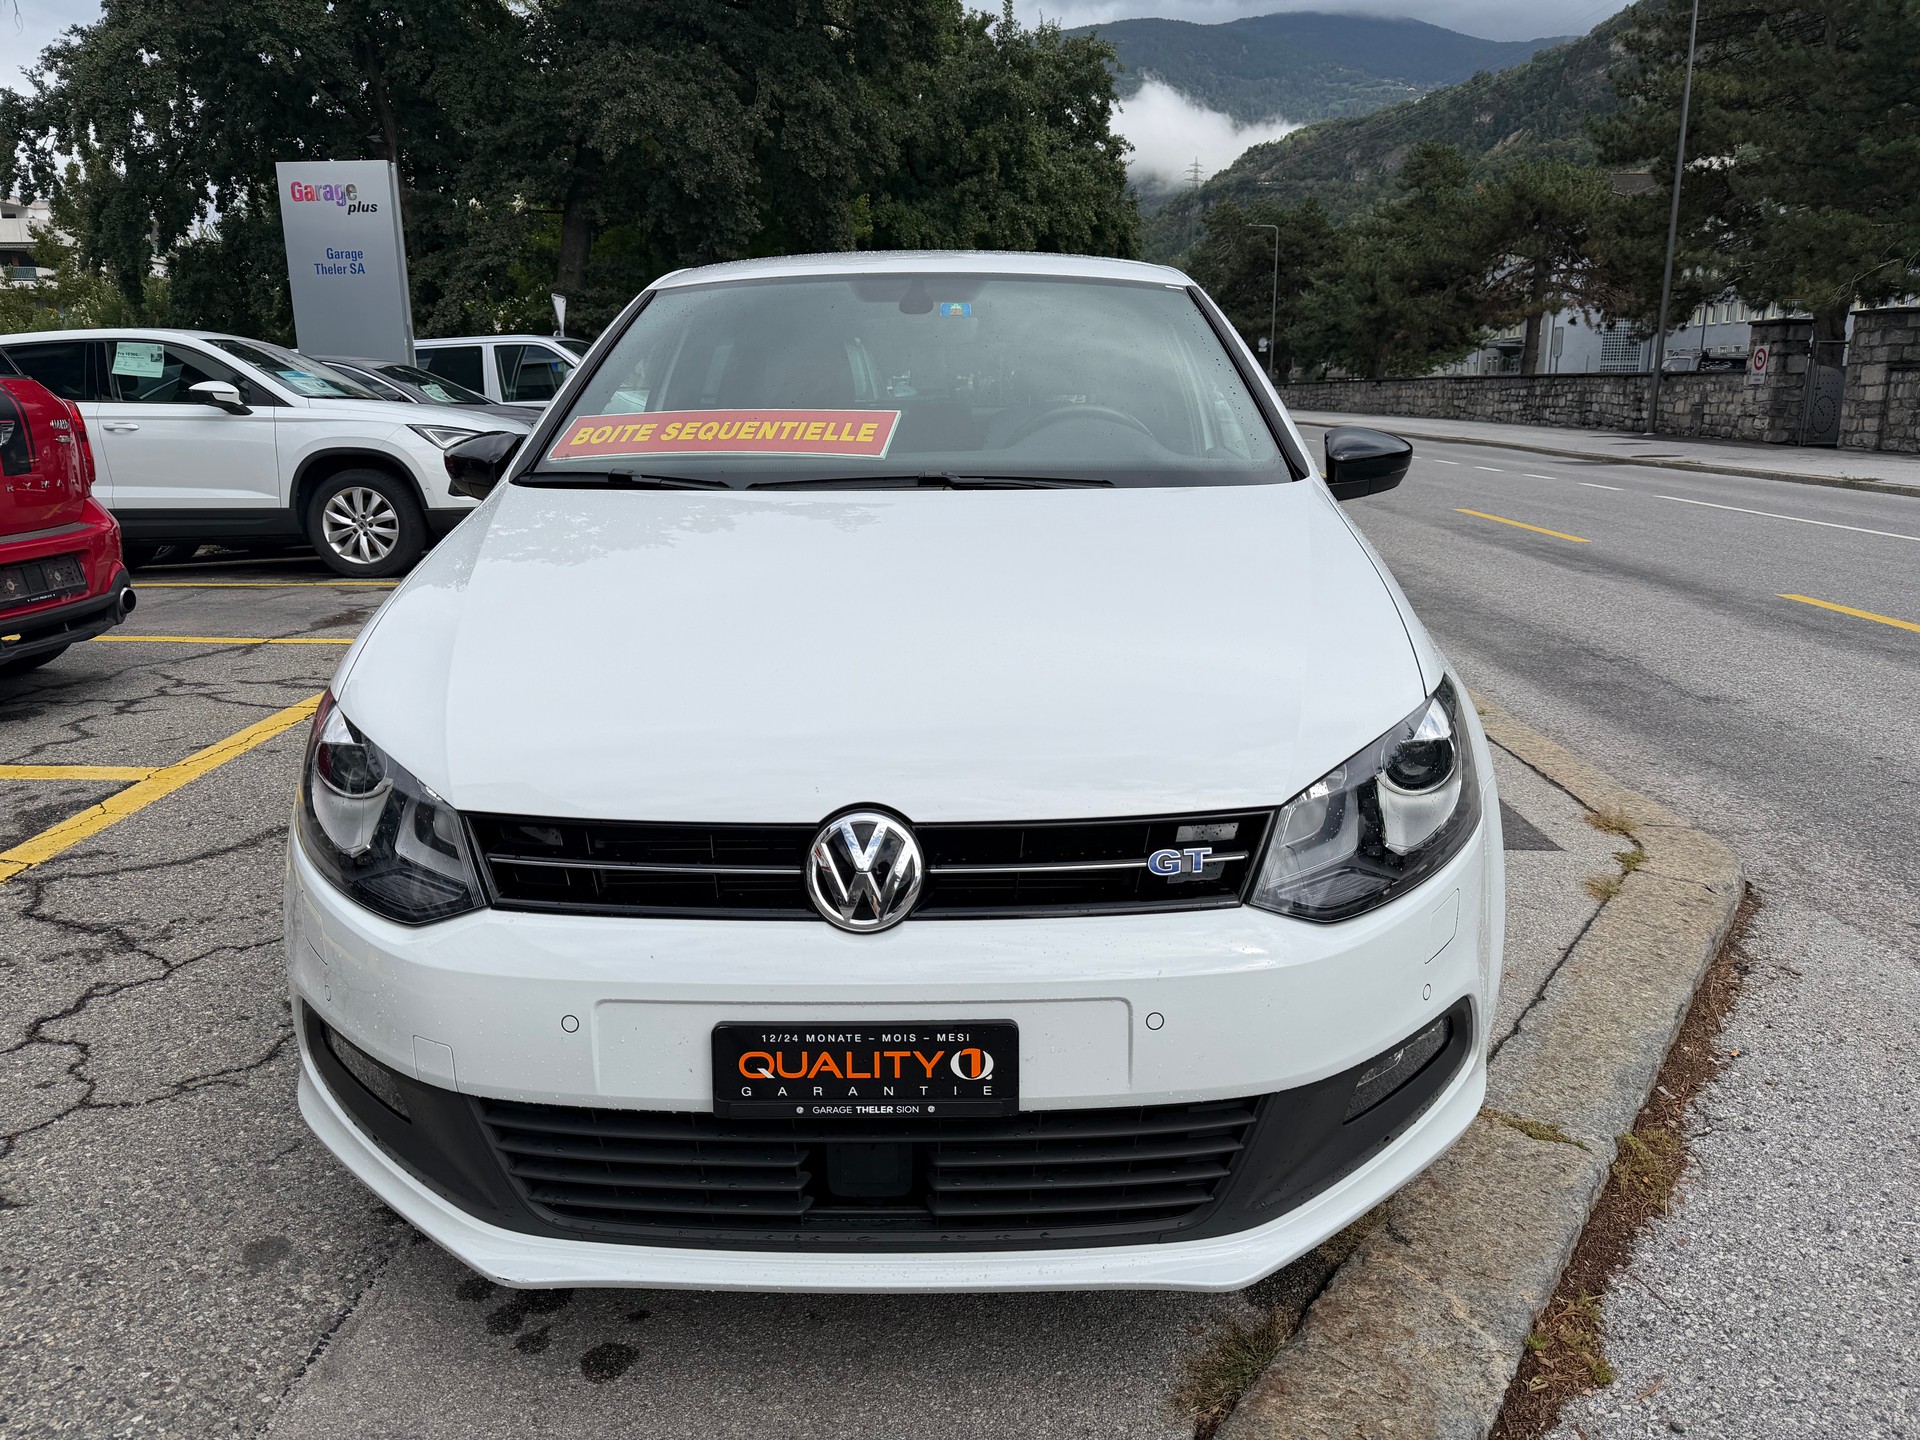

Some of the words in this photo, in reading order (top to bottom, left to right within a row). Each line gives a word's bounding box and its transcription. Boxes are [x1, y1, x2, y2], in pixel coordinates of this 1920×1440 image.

[290, 181, 357, 206] Garage
[347, 200, 378, 215] plus
[326, 247, 363, 261] Garage
[314, 263, 347, 275] Theler
[349, 263, 365, 274] SA
[569, 422, 657, 445] BOITE
[660, 421, 878, 442] SEQUENTIELLE
[1147, 847, 1212, 876] GT
[761, 1034, 799, 1043] 12/24
[806, 1034, 862, 1042] MONATE
[882, 1034, 917, 1042] MOIS
[936, 1033, 970, 1042] MESI
[738, 1050, 944, 1079] QUALITY
[741, 1086, 992, 1096] GARANTIE
[812, 1105, 852, 1114] GARAGE
[856, 1105, 893, 1114] THELER
[896, 1105, 919, 1114] SION
